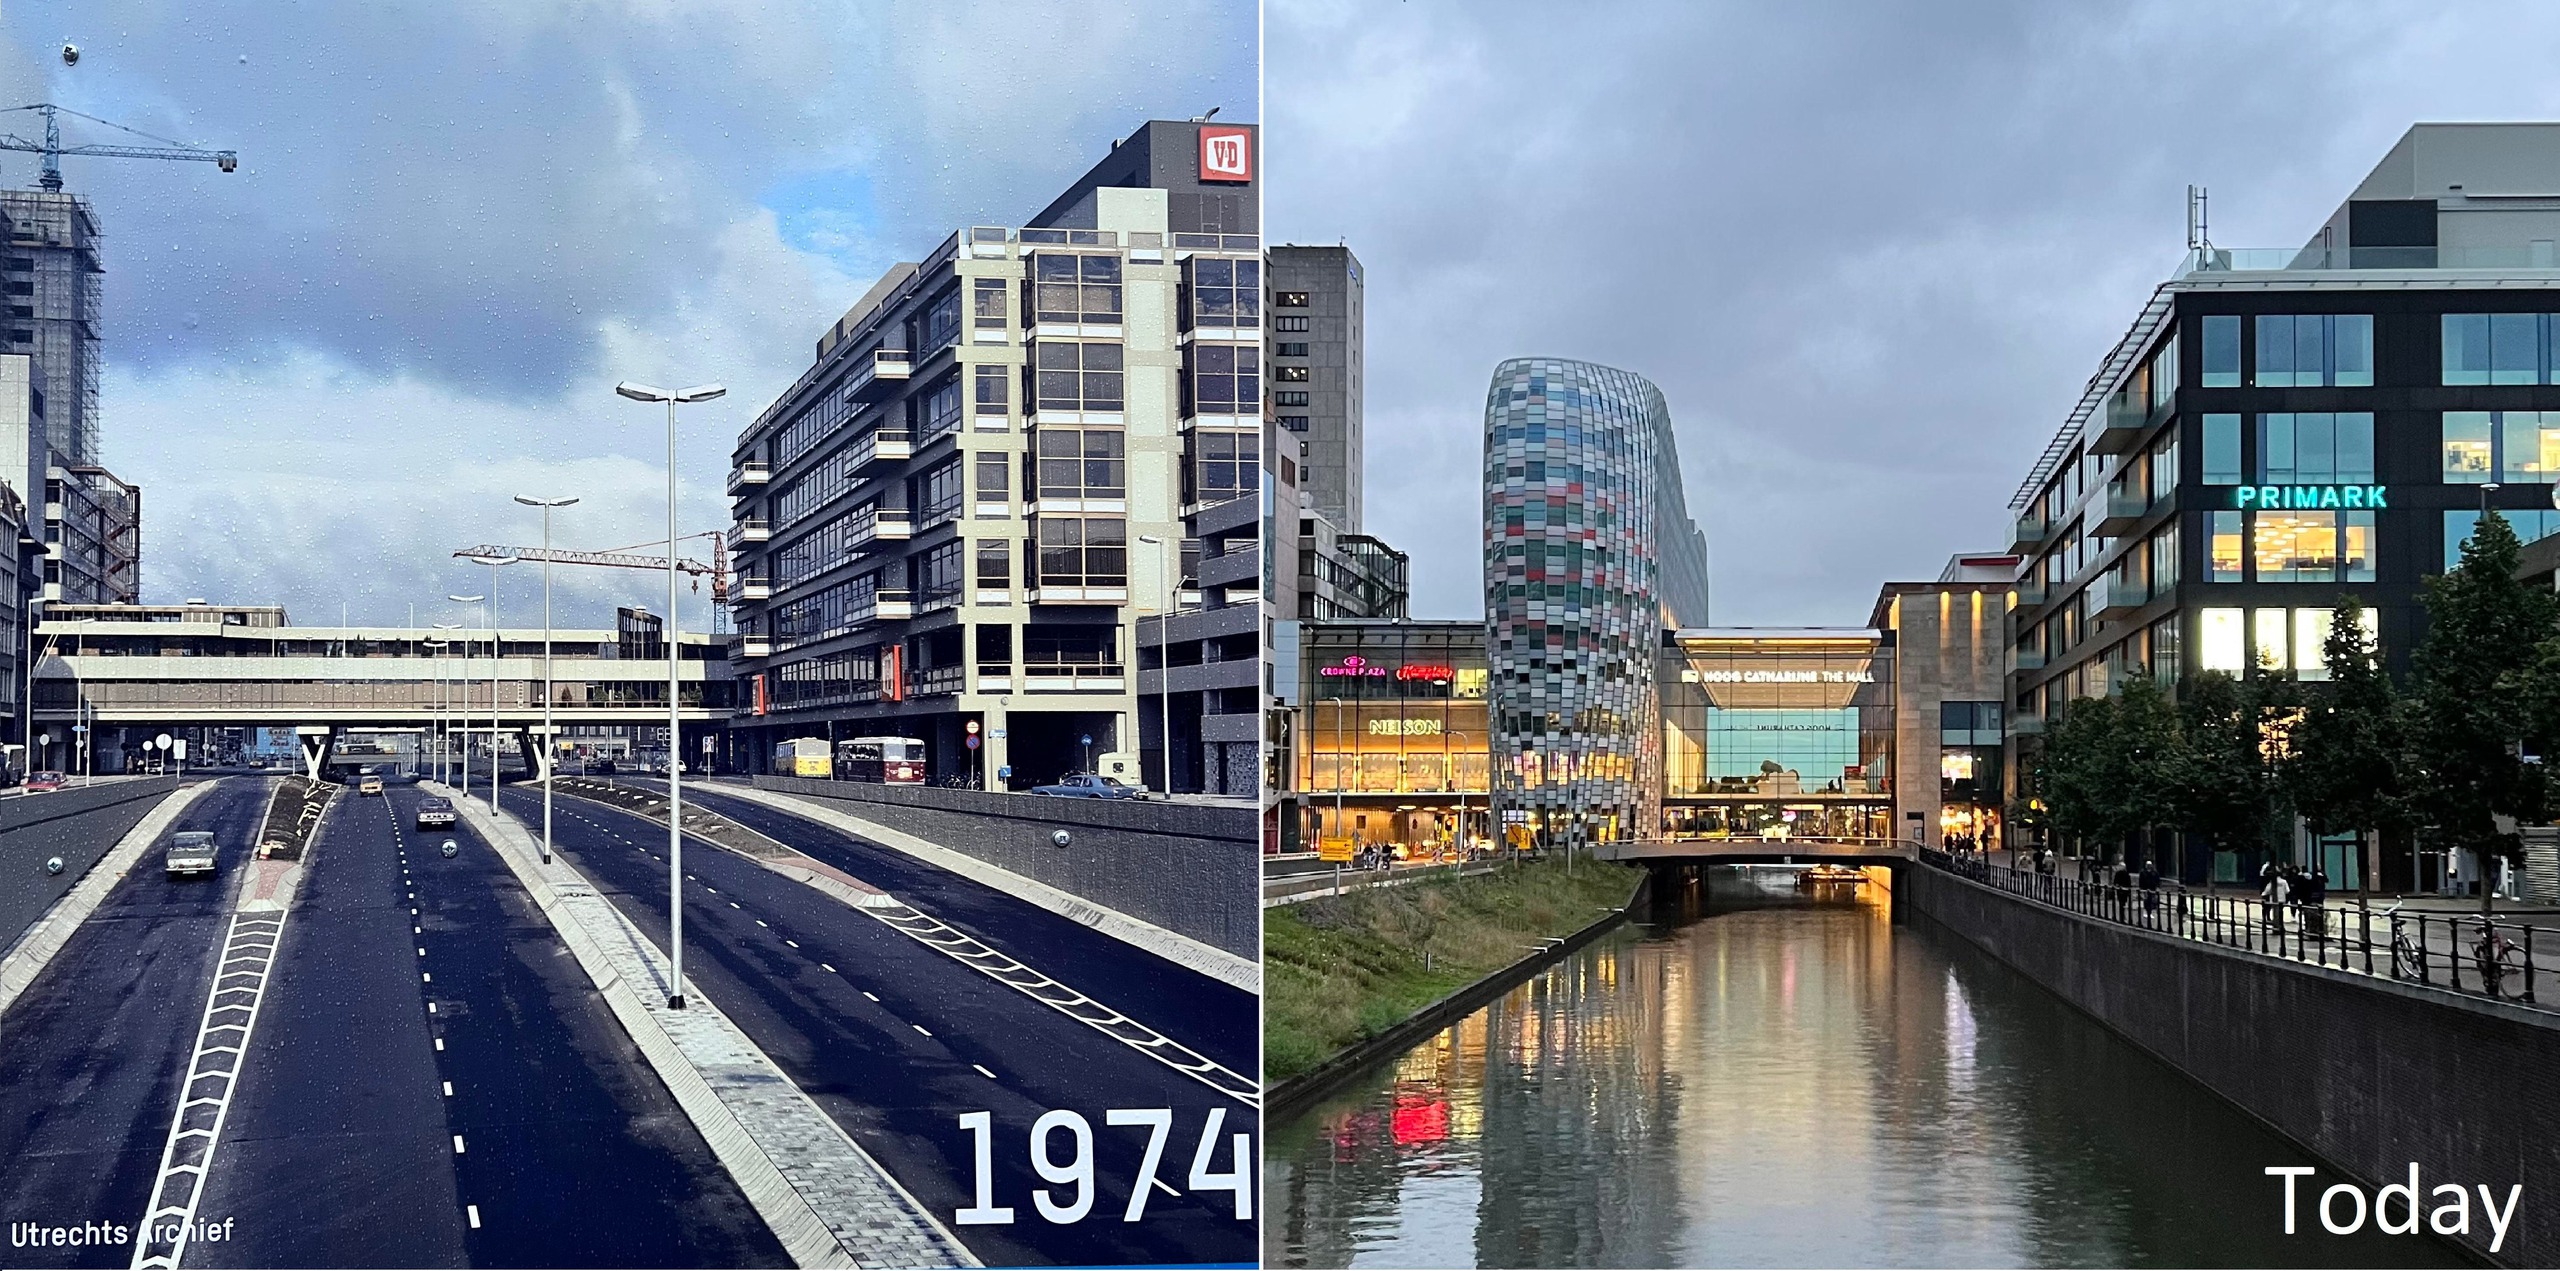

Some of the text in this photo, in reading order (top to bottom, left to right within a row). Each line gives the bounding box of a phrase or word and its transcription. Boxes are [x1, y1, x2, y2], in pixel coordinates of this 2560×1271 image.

[2237, 486, 2388, 509] PRIMARK
[1320, 667, 1357, 676] CROWNE
[1399, 665, 1451, 680] Hampton
[1703, 670, 1876, 683] HOOG CATHARIJNE THE MALL
[1369, 719, 1441, 735] NELSON
